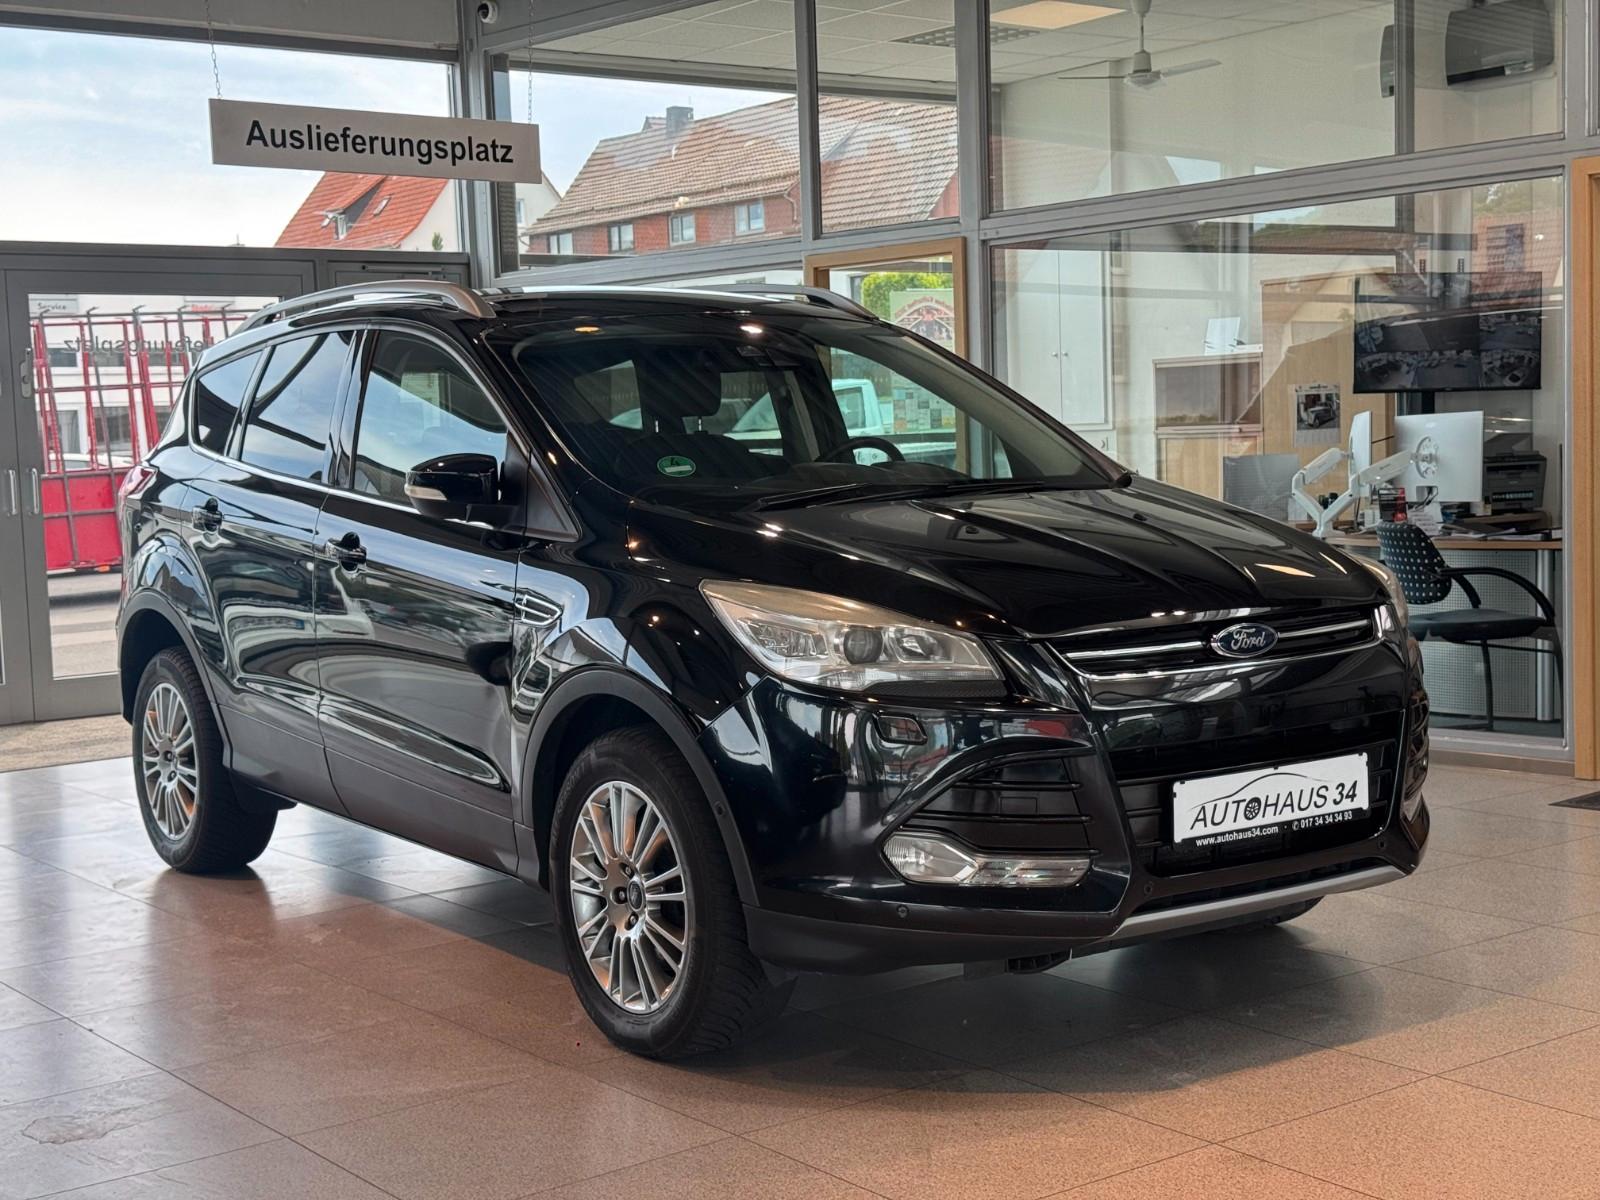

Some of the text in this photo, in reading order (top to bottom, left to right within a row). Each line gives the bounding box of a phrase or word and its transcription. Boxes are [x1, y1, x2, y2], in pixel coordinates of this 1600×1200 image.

[246, 119, 514, 167] Auslieferungsplatz
[1230, 627, 1266, 650] Ford
[1189, 780, 1358, 830] AUTOHAUS 34
[1300, 811, 1353, 829] 017 34 34 34 93
[1195, 825, 1279, 847] www.autohaus34.com
